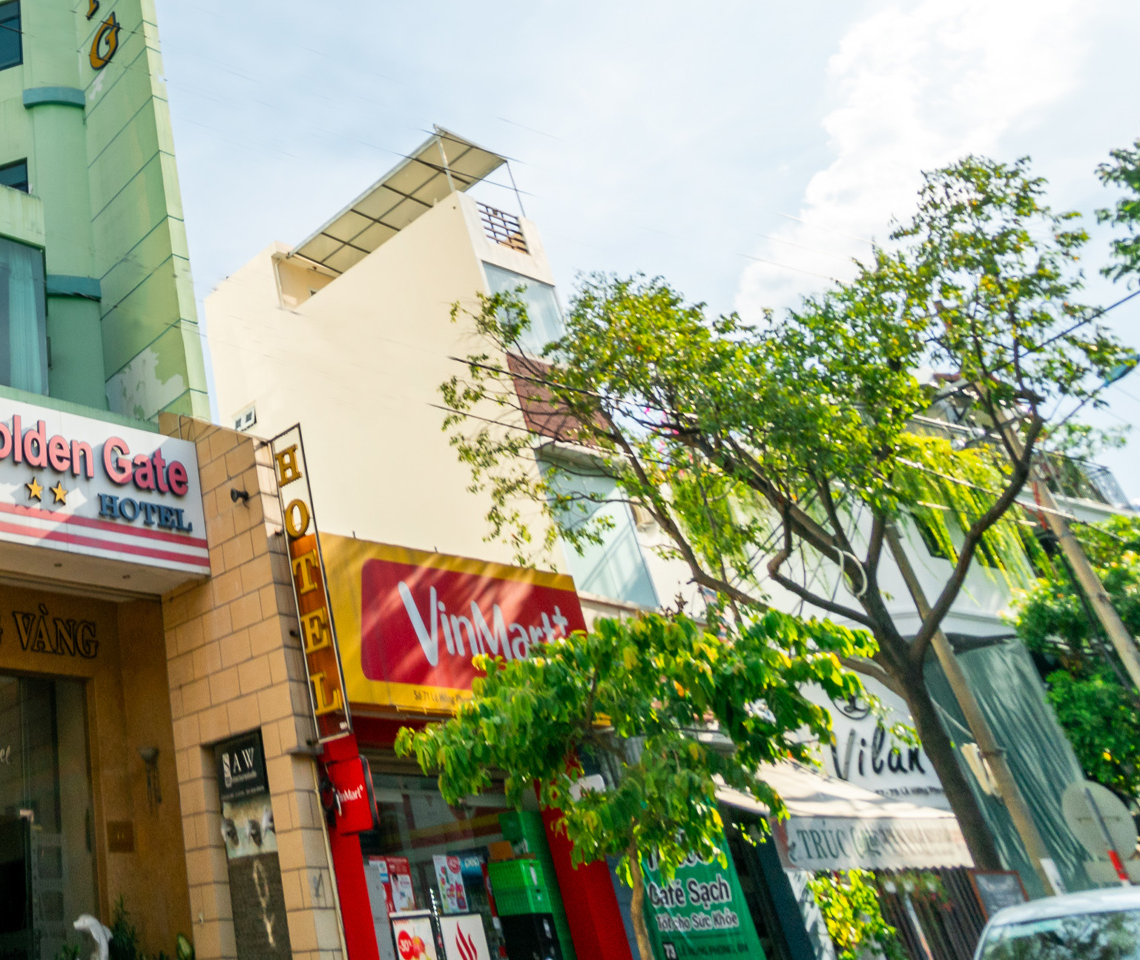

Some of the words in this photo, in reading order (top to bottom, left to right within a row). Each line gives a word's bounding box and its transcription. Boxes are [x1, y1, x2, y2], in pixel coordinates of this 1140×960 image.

[102, 436, 189, 497] Gate
[98, 492, 193, 533] HOTEL
[275, 443, 343, 716] HOTEL
[12, 603, 100, 659] VÀNG
[687, 873, 732, 910] Sạch
